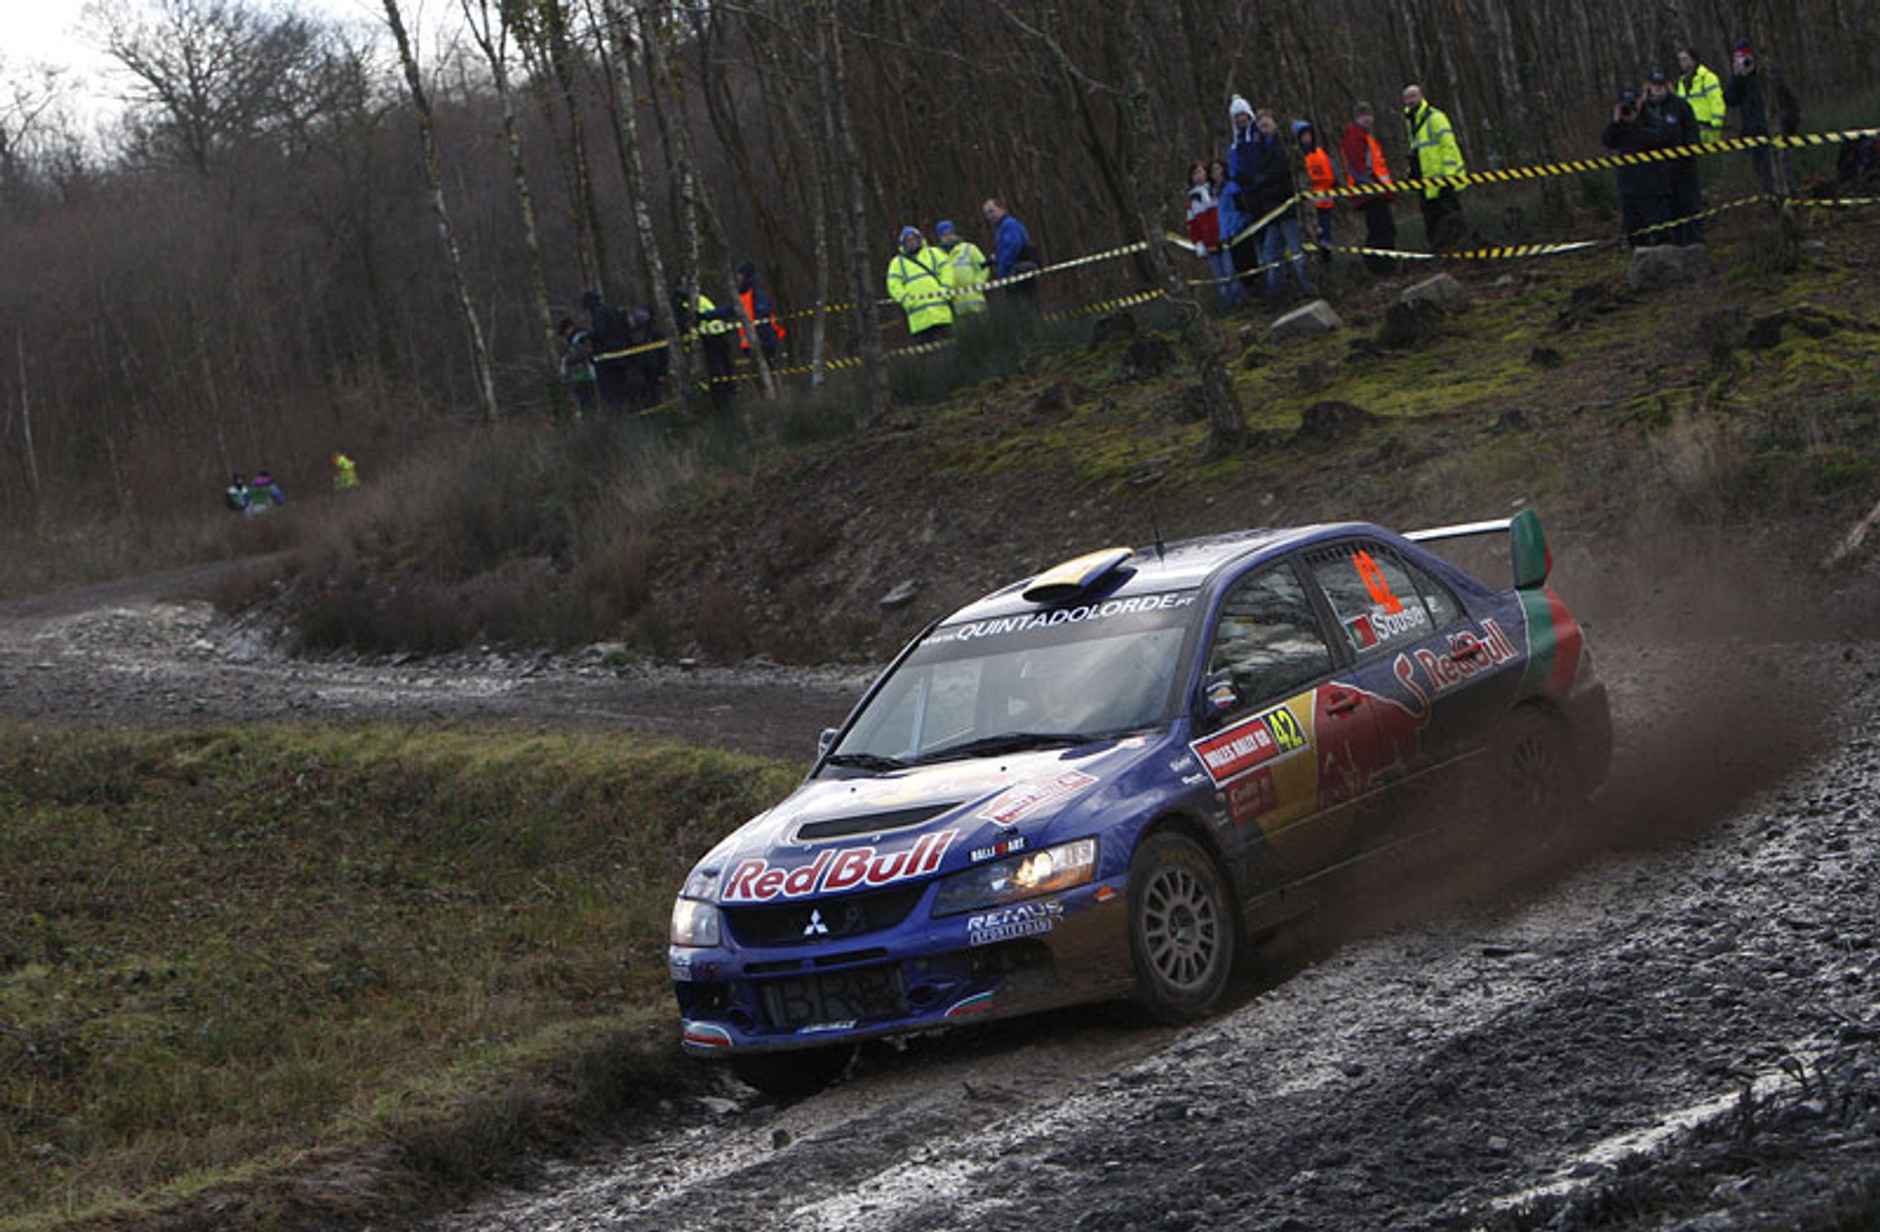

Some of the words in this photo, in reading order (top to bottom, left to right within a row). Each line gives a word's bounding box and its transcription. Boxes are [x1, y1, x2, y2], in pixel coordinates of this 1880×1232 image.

[1371, 606, 1425, 640] Sousa
[1268, 709, 1303, 750] 42
[722, 849, 834, 901] Red
[820, 829, 959, 892] Bull
[967, 900, 1060, 931] REMUS
